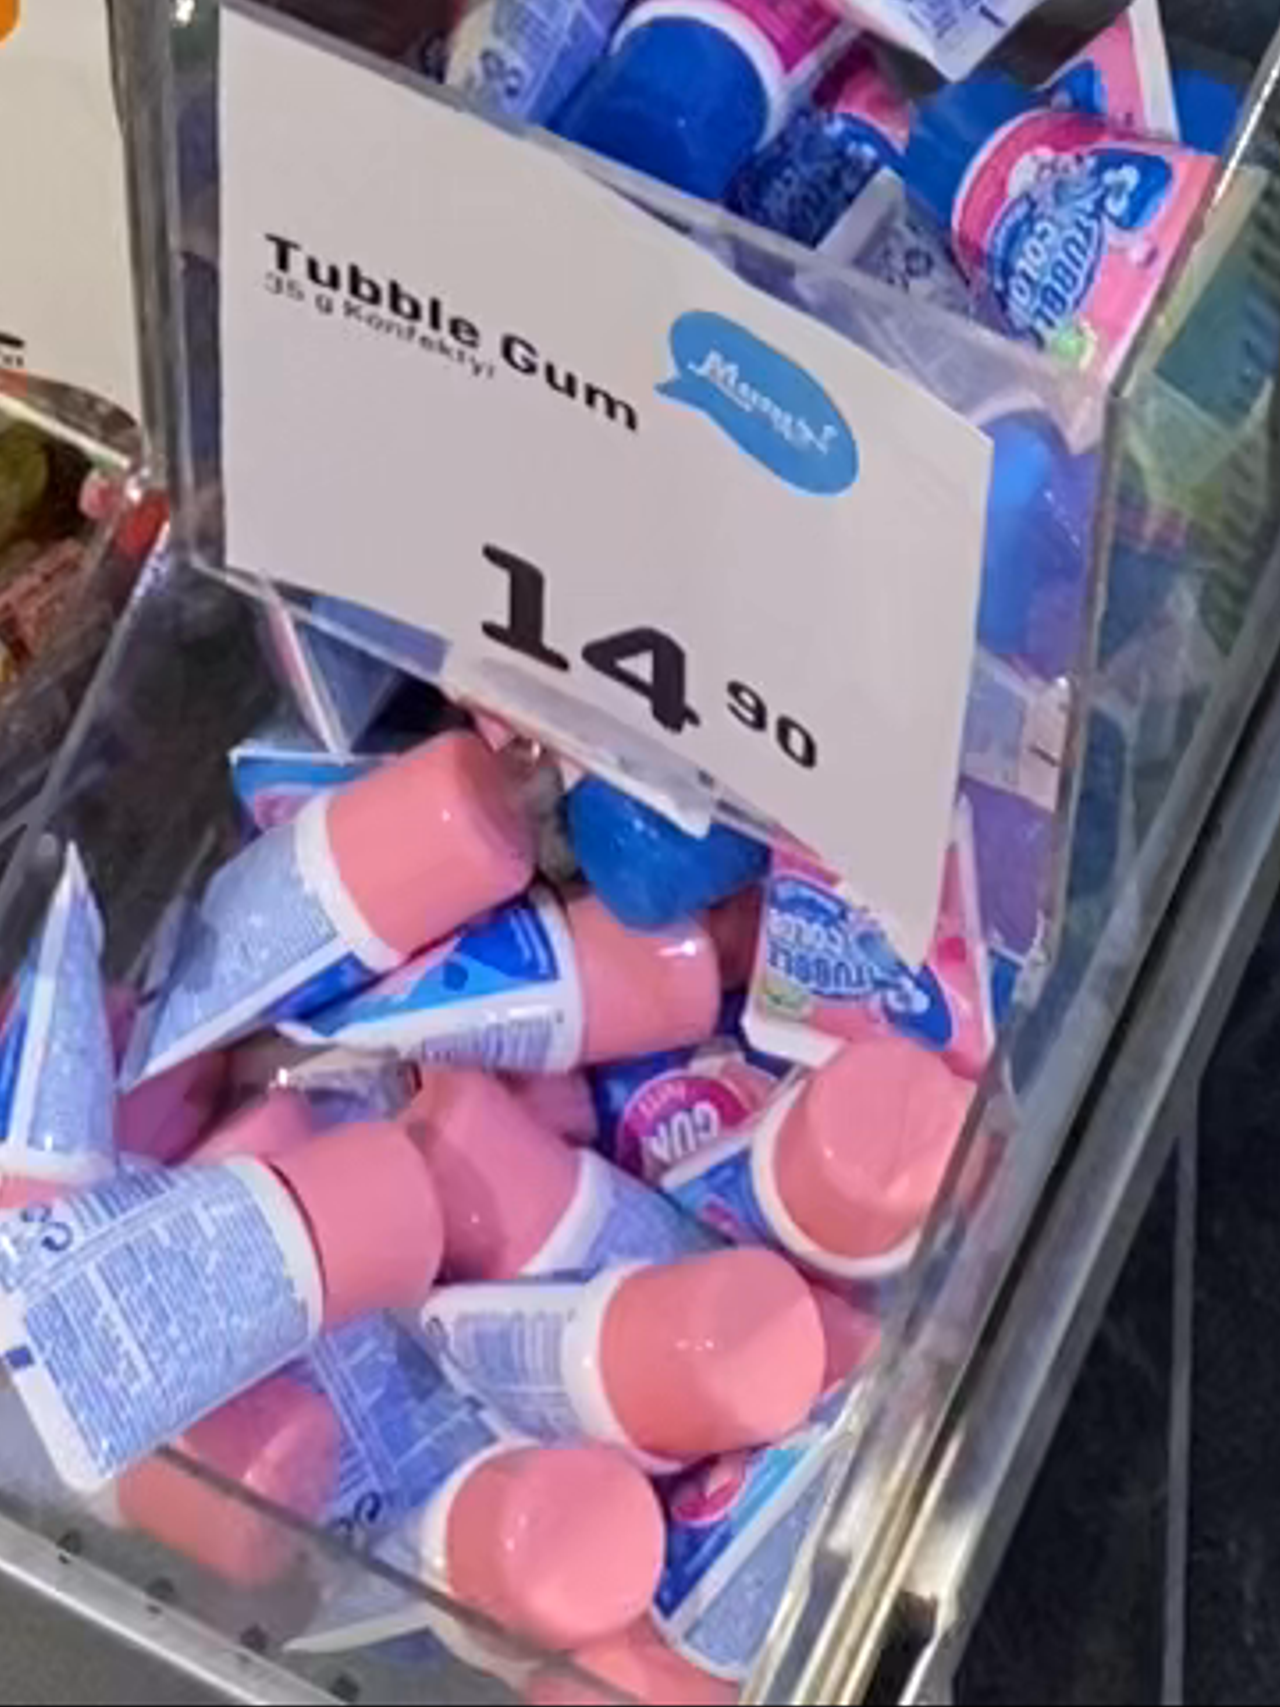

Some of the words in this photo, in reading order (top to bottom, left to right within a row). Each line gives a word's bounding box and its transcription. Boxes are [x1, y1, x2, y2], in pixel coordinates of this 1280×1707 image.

[265, 233, 481, 350] Tubble
[500, 330, 639, 434] Gum
[314, 293, 335, 317] g
[480, 541, 701, 737] 14
[726, 676, 820, 774] 90
